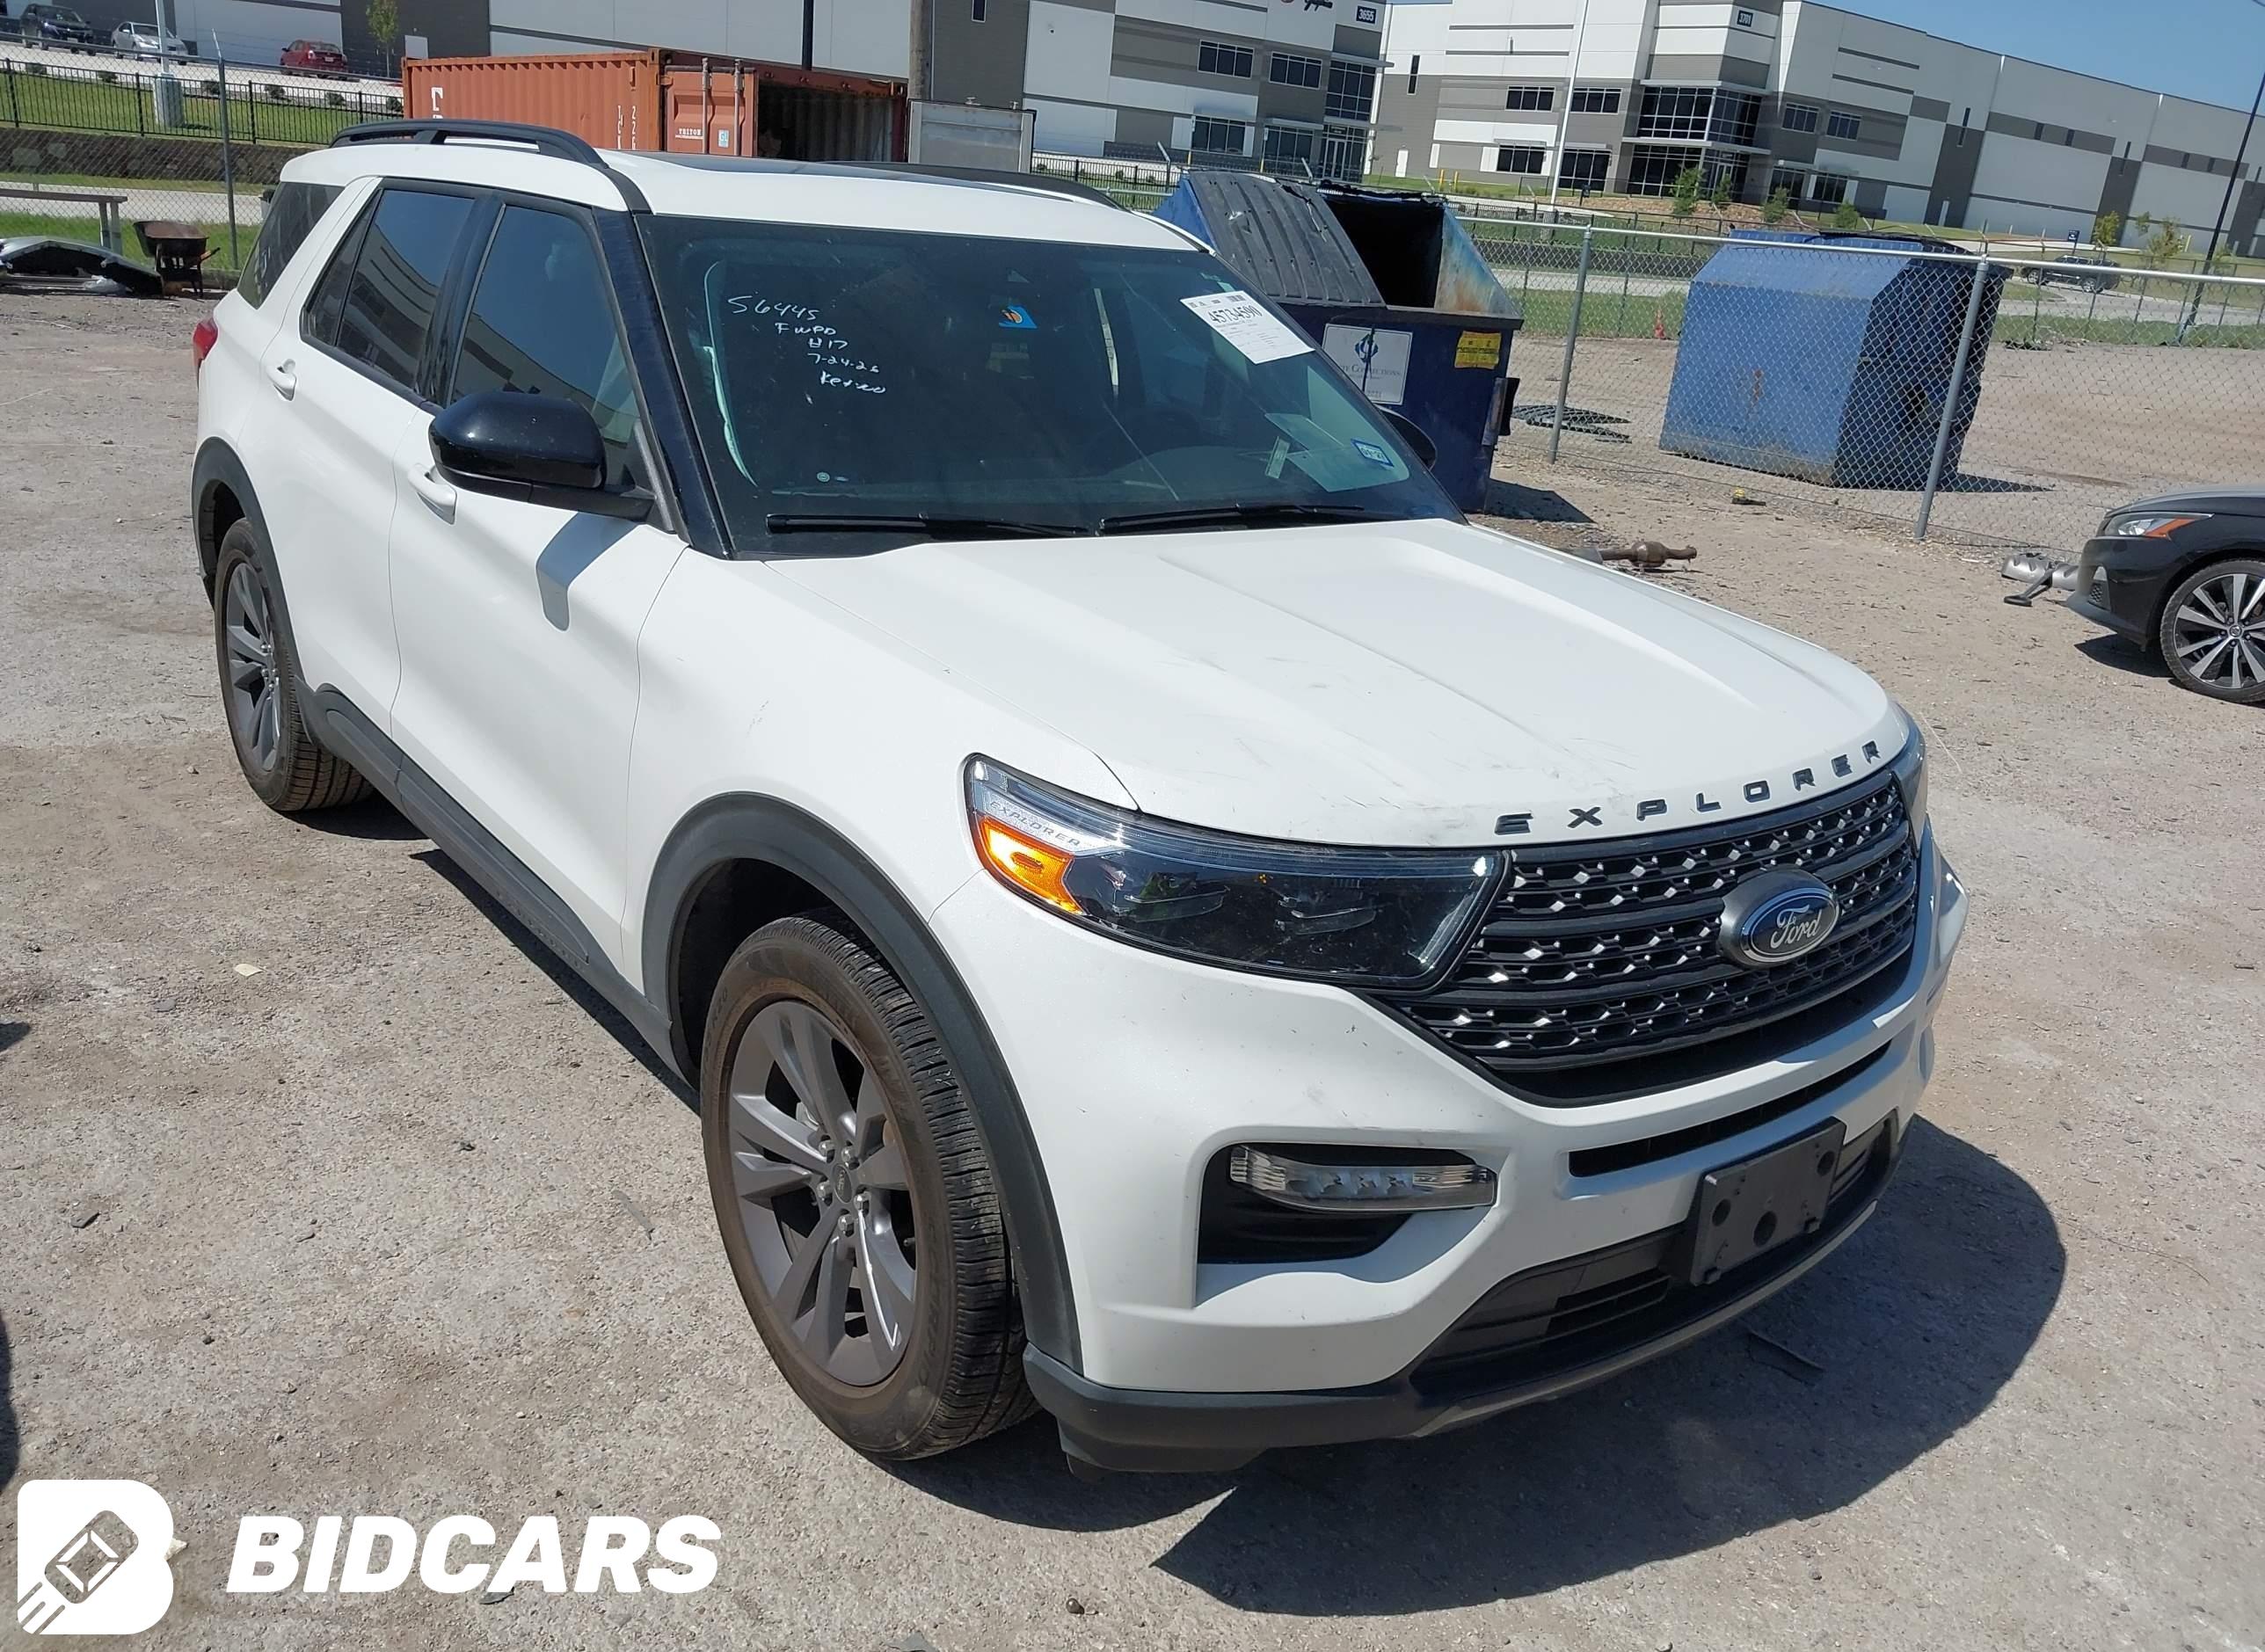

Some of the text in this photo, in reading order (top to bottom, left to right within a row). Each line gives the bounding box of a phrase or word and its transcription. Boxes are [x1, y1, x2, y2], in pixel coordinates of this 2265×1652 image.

[678, 127, 702, 136] TRITON
[1207, 304, 1264, 324] 45734590
[1494, 739, 1881, 836] EXPLORER
[990, 801, 1081, 847] EXPLORER
[1770, 904, 1823, 950] Ford
